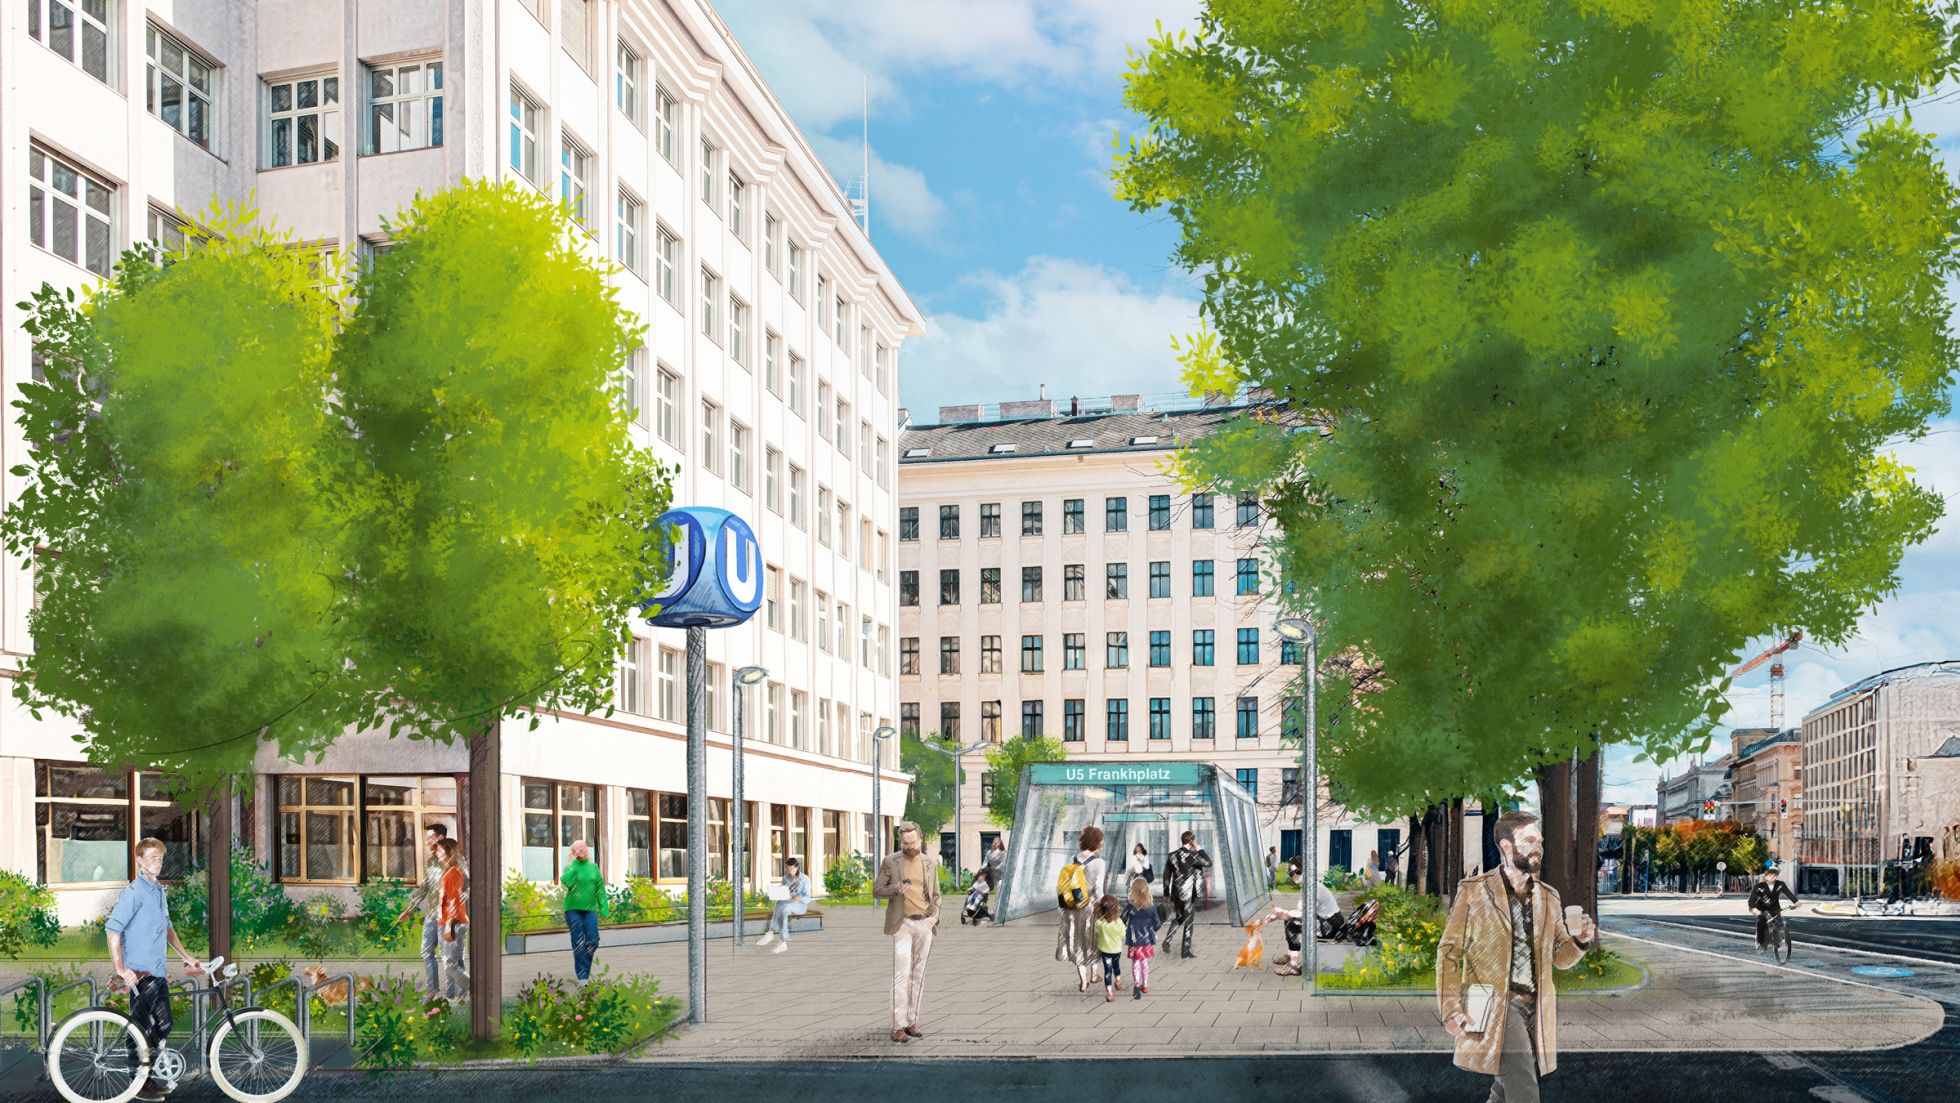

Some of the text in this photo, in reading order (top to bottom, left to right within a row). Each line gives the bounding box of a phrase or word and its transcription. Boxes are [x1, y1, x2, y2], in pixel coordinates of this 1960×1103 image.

[726, 526, 757, 604] U
[1066, 767, 1171, 782] U5 Frankhplatz
